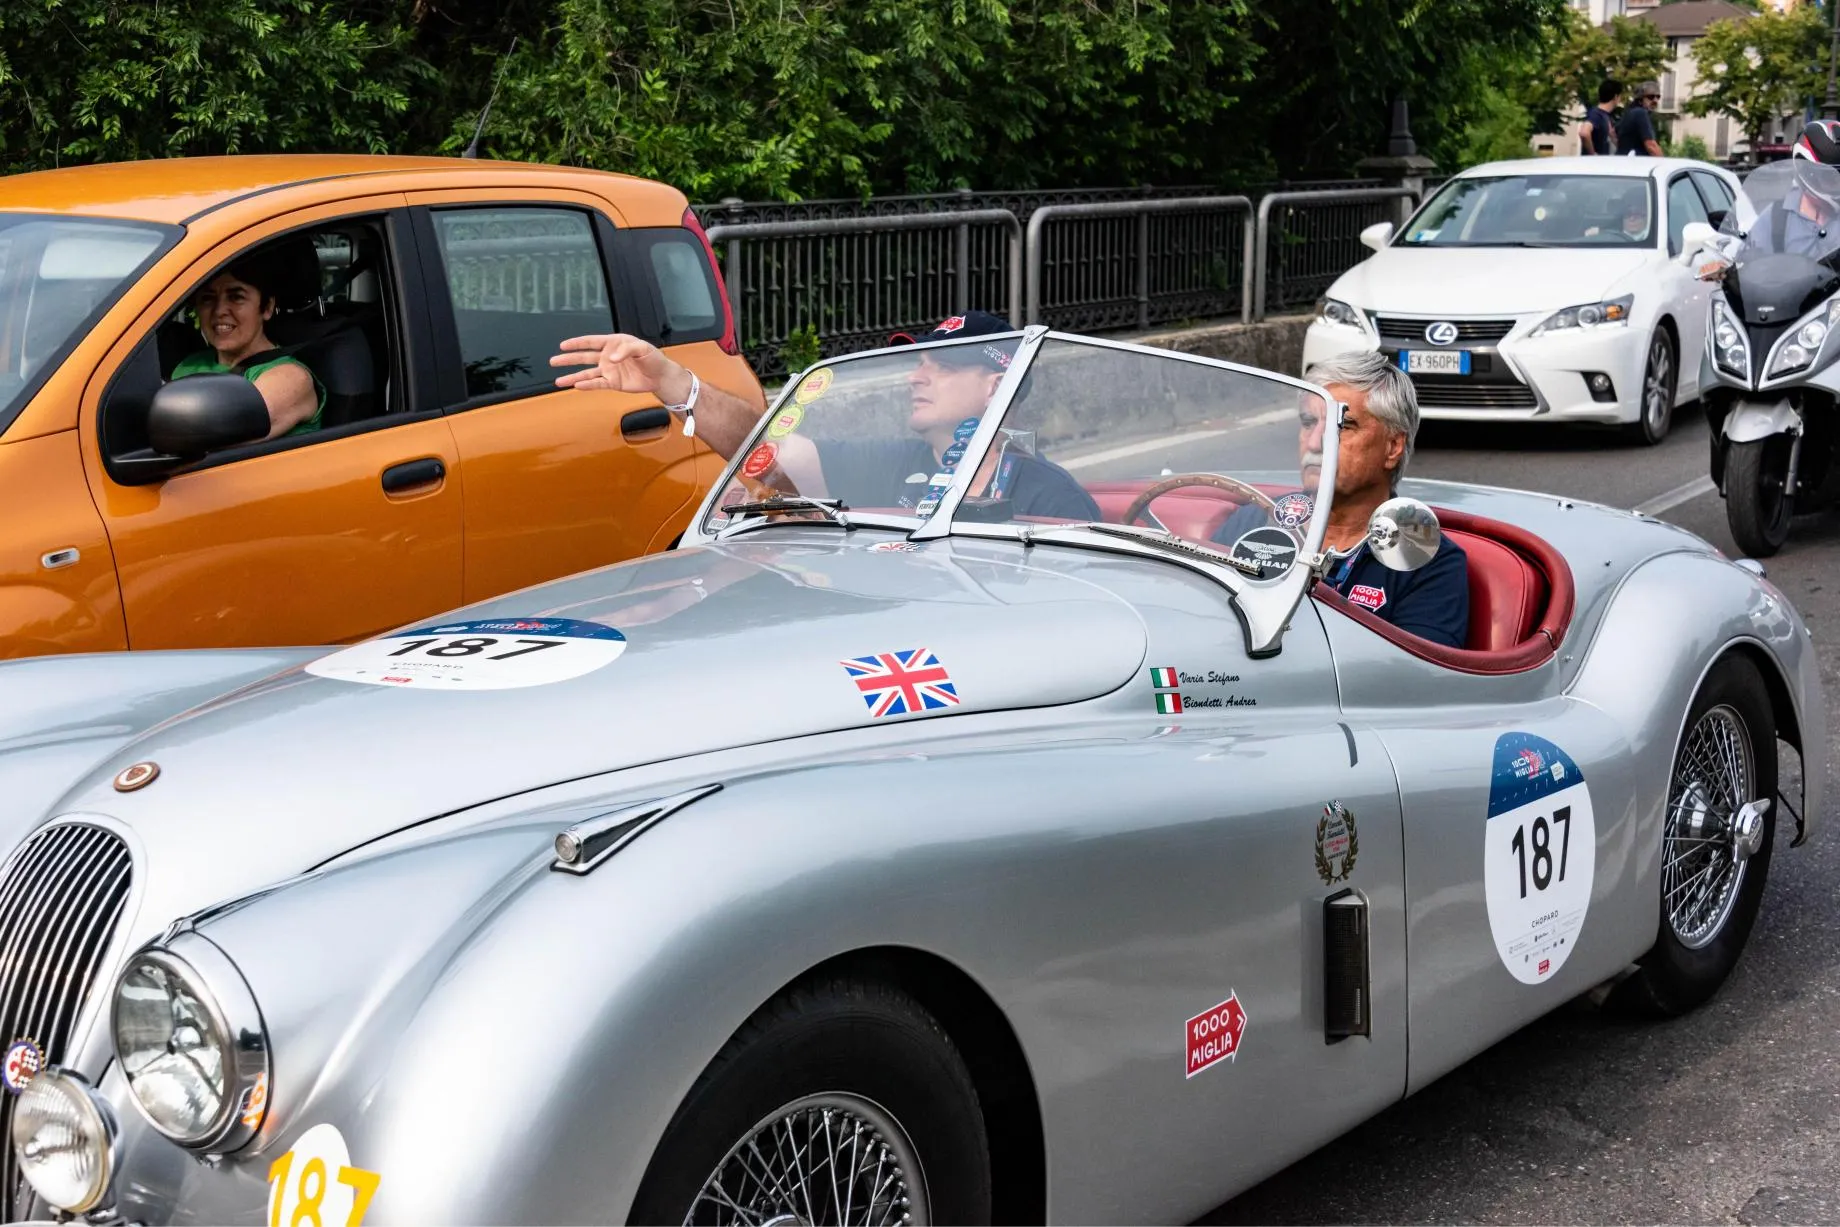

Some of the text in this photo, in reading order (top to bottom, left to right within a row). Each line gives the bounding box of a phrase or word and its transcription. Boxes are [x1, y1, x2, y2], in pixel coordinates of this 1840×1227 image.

[1351, 593, 1378, 607] MIGLIA
[1356, 586, 1379, 597] 1000
[387, 638, 568, 661] 187
[1179, 671, 1240, 685] Varia Stefano
[1183, 695, 1257, 708] Biondetti Andrea
[1512, 805, 1571, 899] 187
[1531, 910, 1559, 928] CHOPARD
[1194, 1009, 1230, 1041] 1000
[1191, 1032, 1233, 1068] MIGLIA
[267, 1150, 381, 1227] 187
